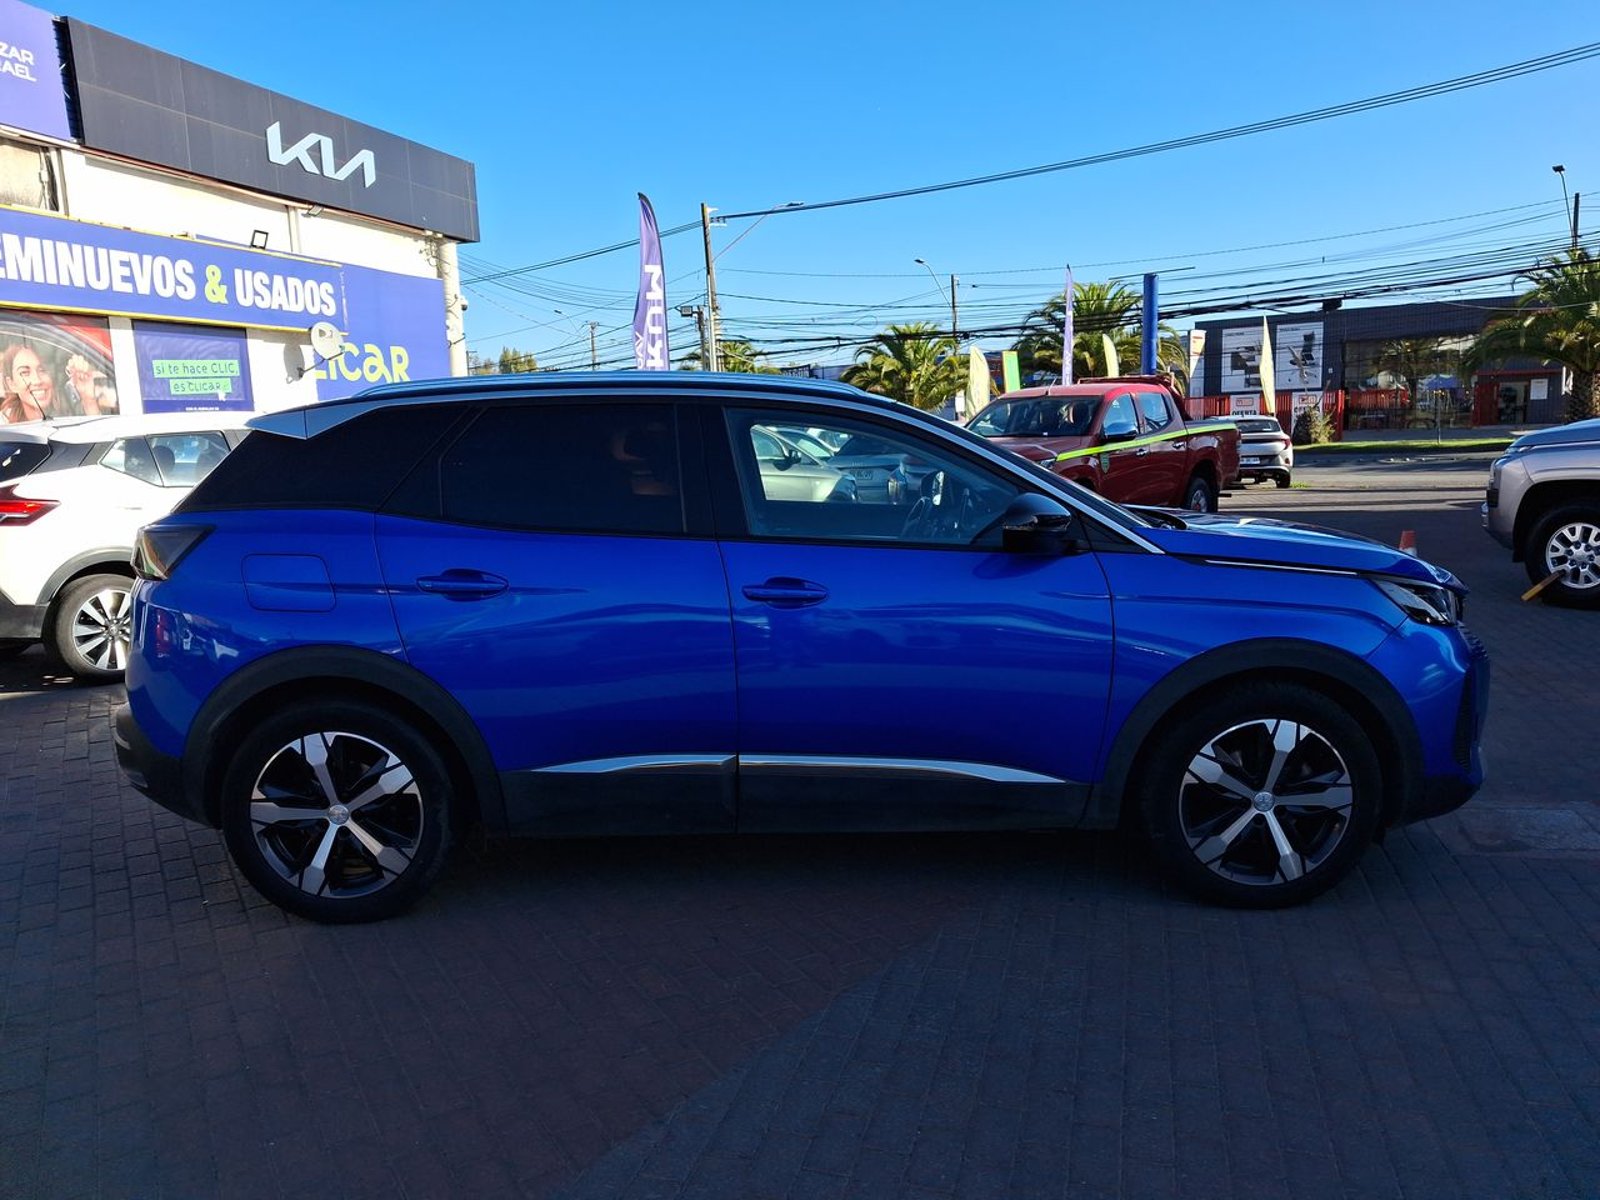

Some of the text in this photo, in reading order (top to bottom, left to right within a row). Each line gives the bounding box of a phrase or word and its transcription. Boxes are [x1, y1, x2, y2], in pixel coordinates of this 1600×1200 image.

[205, 264, 228, 304] &
[234, 268, 336, 316] USADOS
[155, 363, 165, 375] si
[168, 364, 179, 375] te
[183, 363, 208, 374] hace
[173, 383, 186, 392] es
